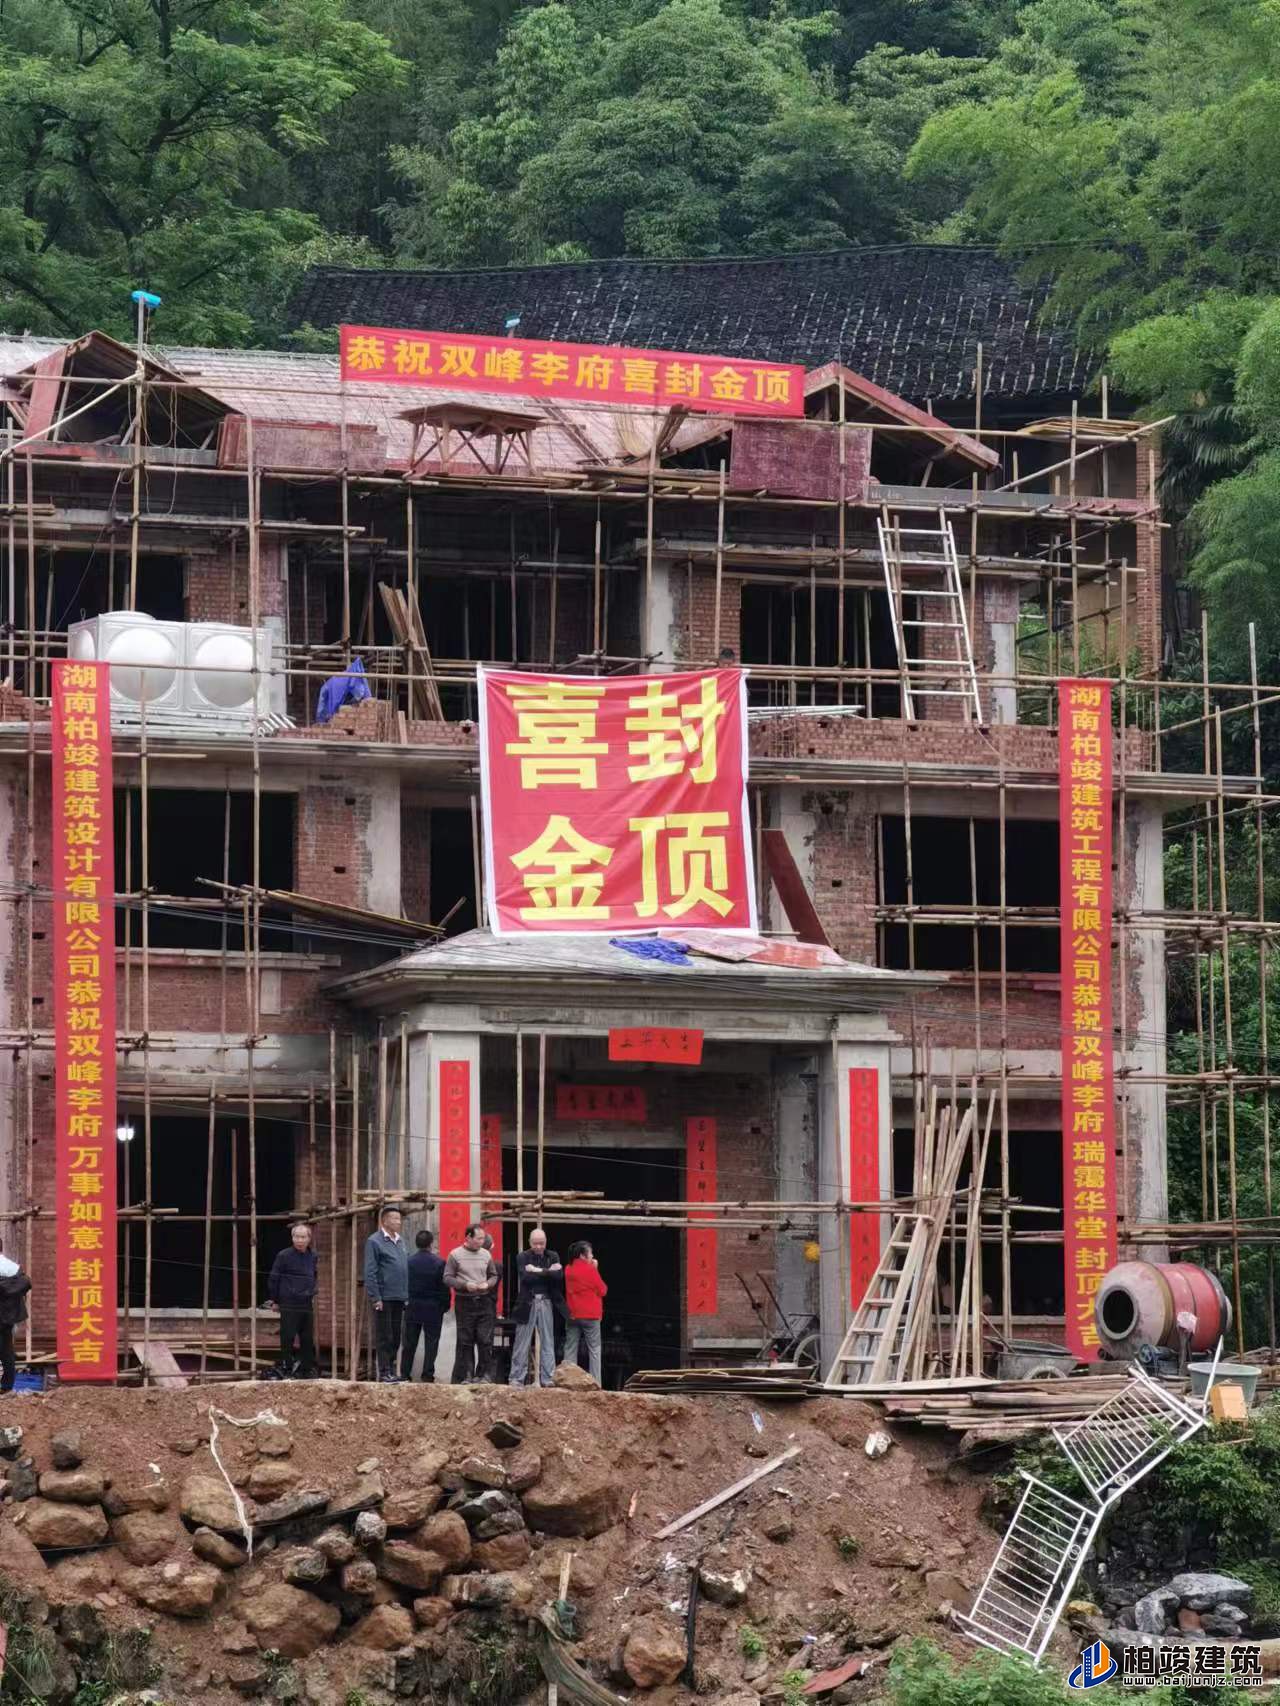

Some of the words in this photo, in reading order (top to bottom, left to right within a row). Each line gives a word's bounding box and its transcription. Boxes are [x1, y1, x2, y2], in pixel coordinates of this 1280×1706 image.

[347, 335, 792, 405] 恭祝双峰李府喜封金顶
[505, 677, 727, 790] 喜封
[510, 811, 735, 921] 金顶
